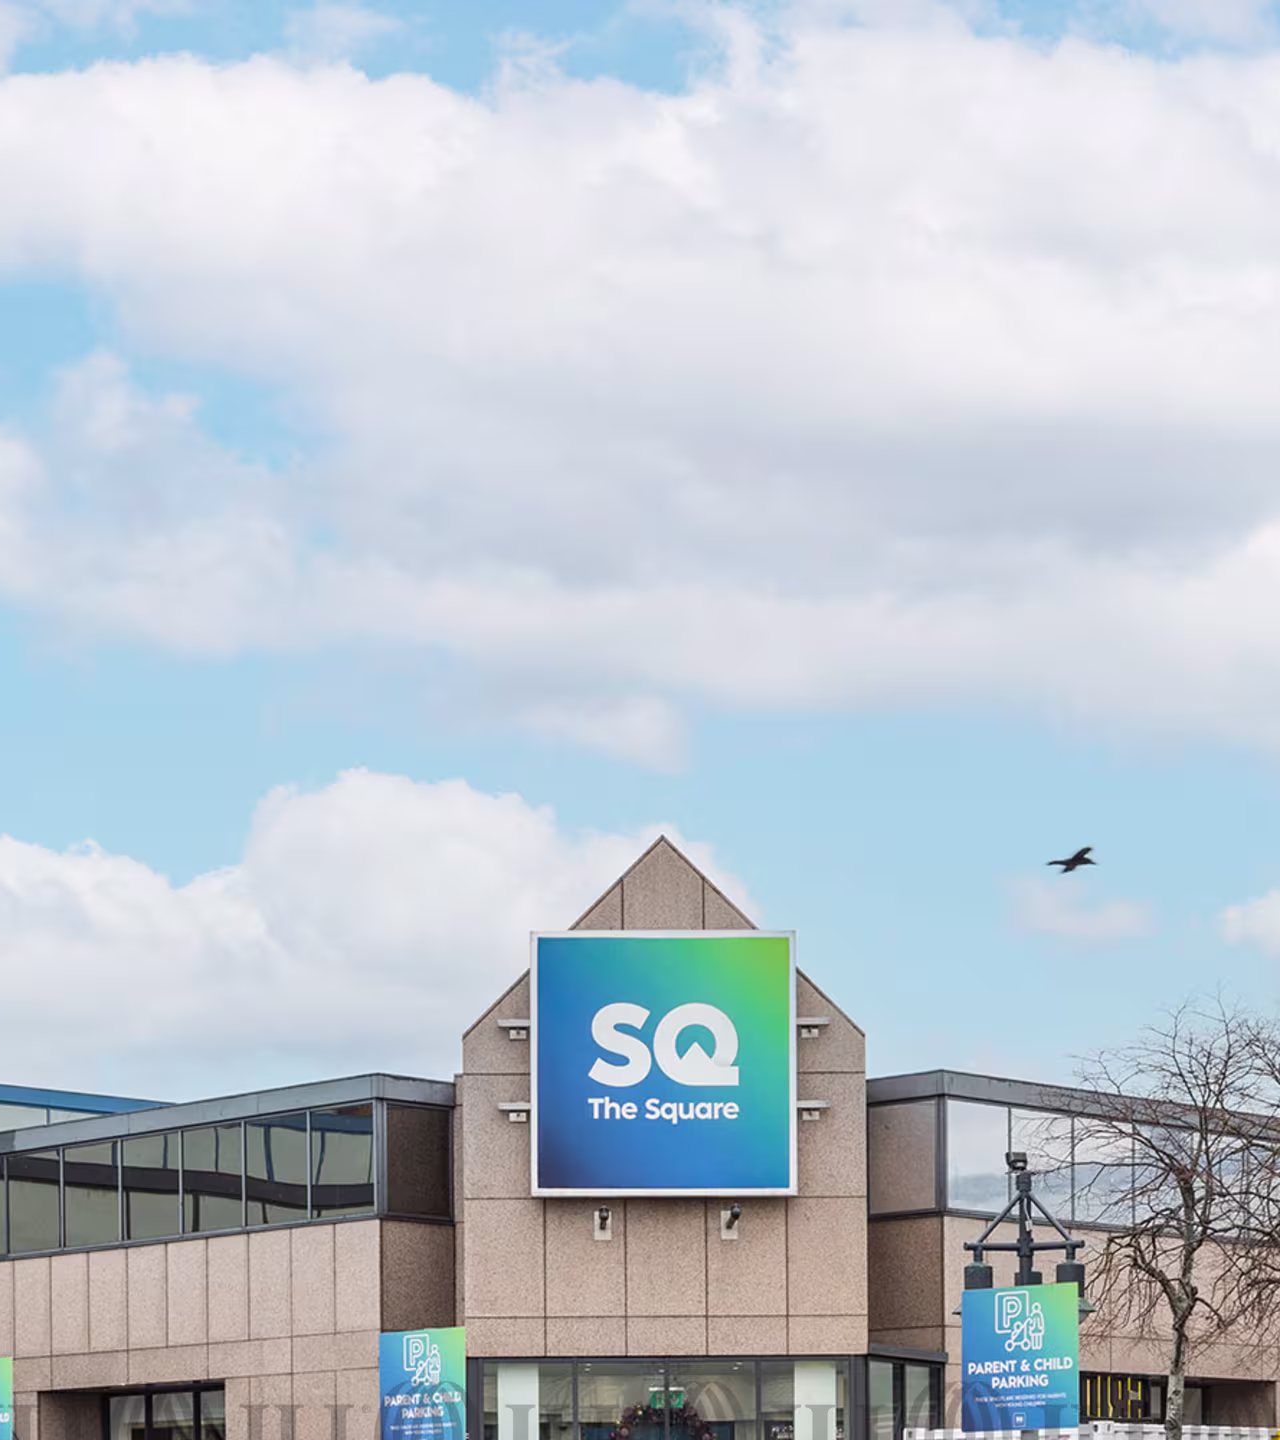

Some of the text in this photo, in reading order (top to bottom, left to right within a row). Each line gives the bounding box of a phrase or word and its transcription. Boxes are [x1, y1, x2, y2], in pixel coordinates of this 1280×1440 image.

[587, 1002, 739, 1087] SQ
[588, 1098, 739, 1124] The Square
[968, 1356, 1073, 1375] PARENT & CHILD
[991, 1374, 1049, 1389] PARKING
[384, 1391, 462, 1407] PARENT & CHILD
[402, 1406, 444, 1419] PARKING
